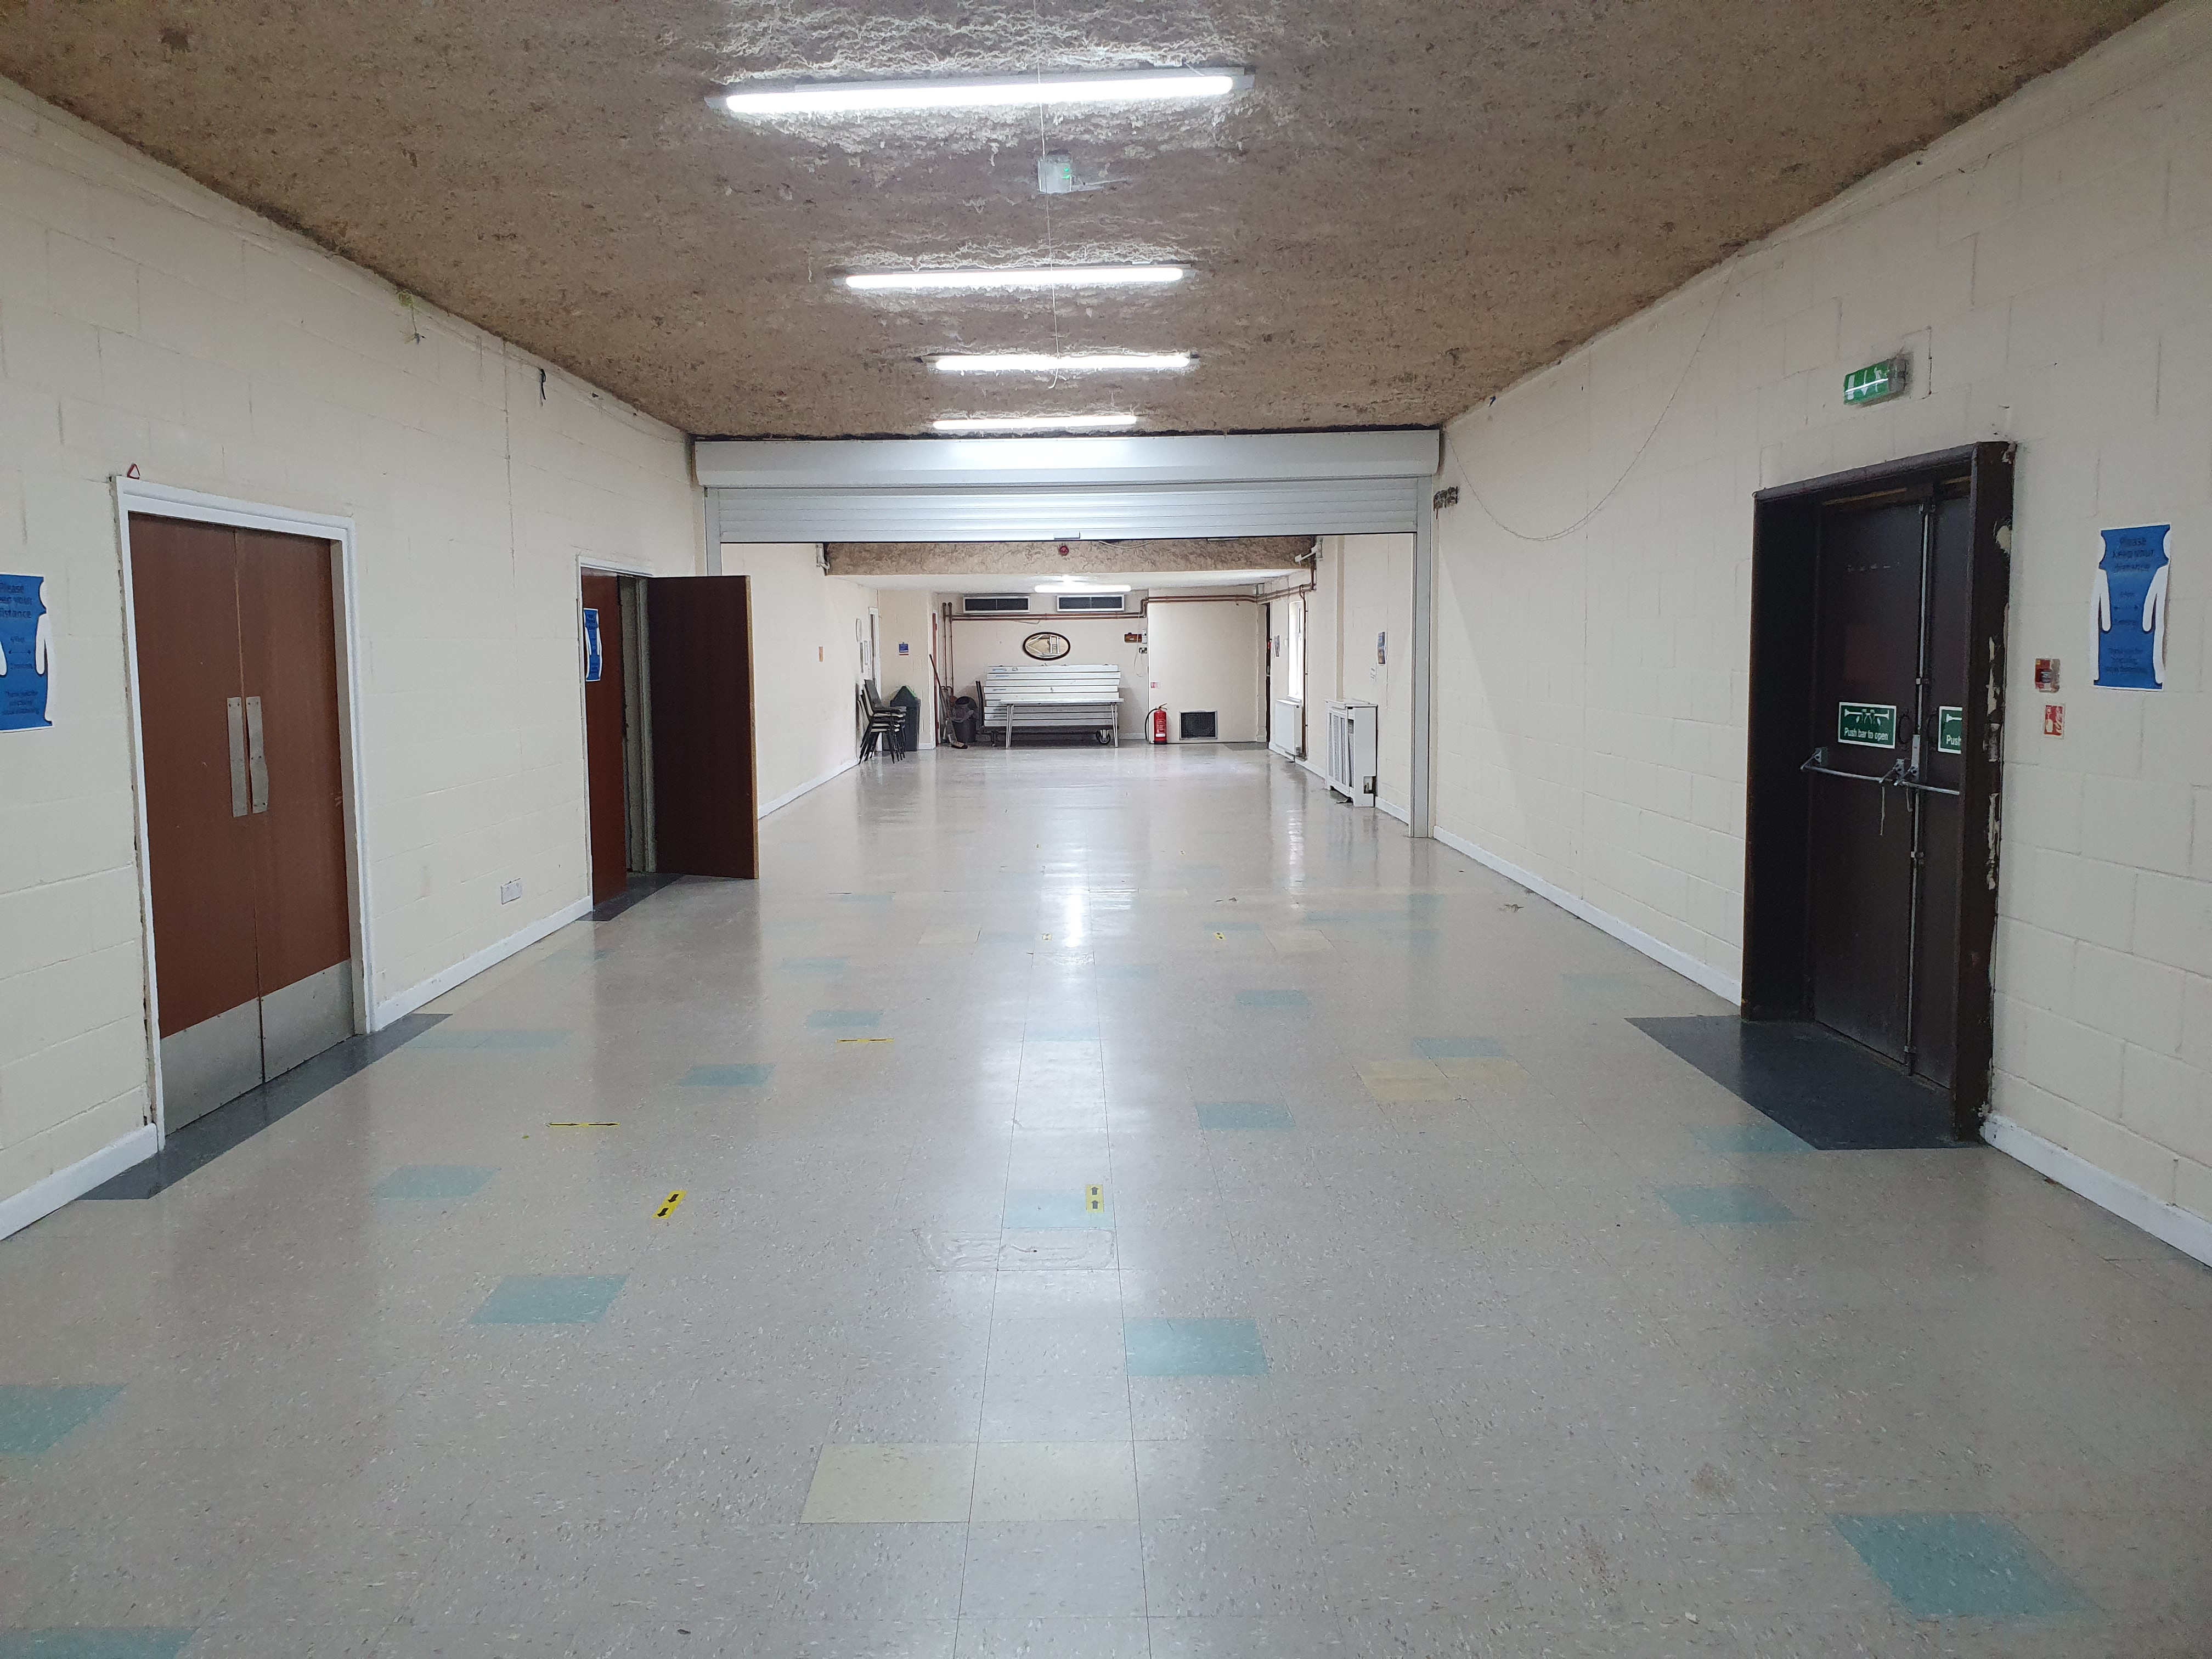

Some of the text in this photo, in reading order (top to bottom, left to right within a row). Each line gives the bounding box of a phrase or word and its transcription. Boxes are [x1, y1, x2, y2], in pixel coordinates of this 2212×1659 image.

[1844, 727, 1888, 742] Push bar to open
